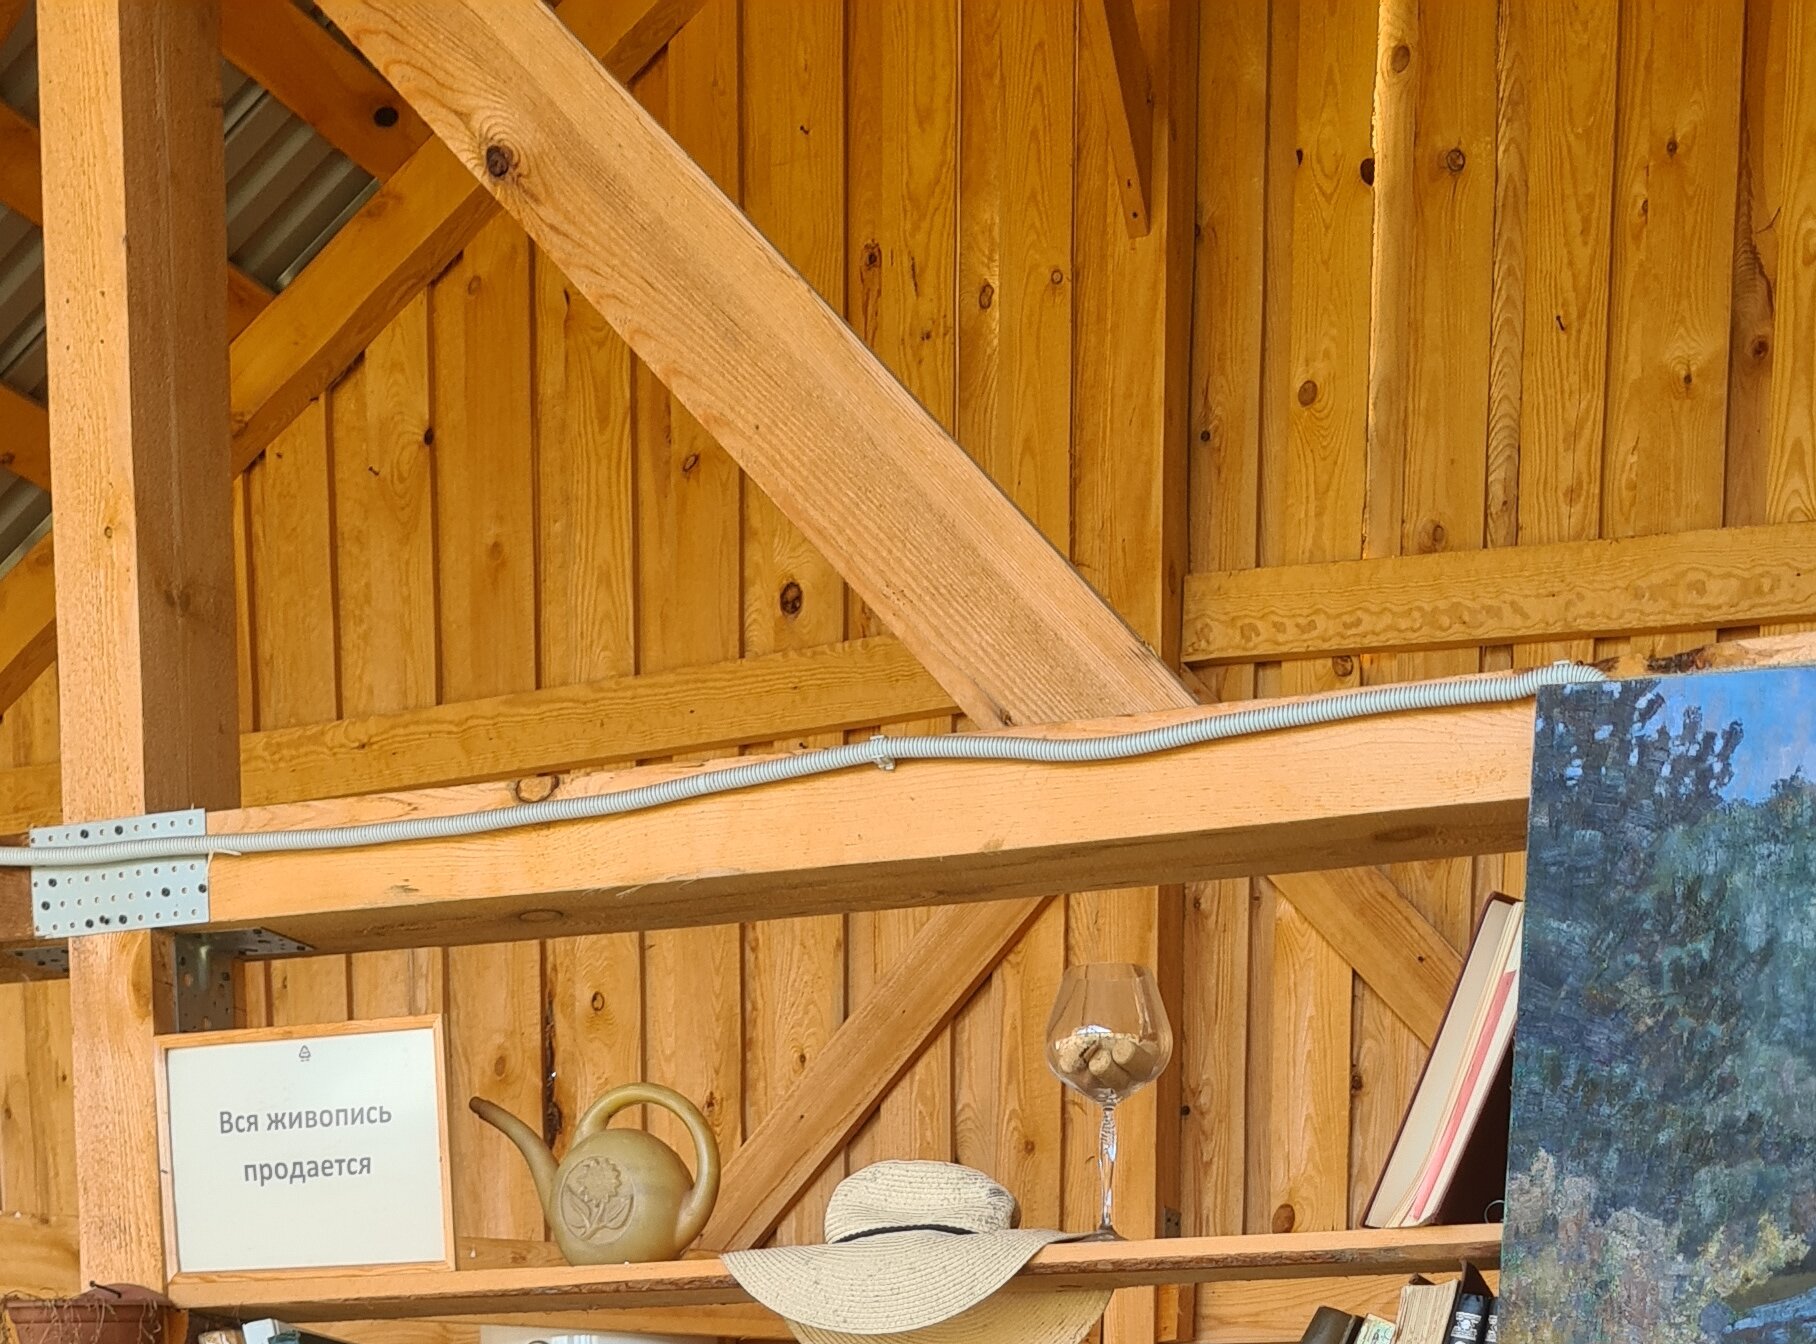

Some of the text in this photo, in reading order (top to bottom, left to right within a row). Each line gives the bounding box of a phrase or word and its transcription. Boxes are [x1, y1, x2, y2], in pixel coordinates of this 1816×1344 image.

[220, 1105, 391, 1134] Вся живопись
[244, 1157, 371, 1186] продается
